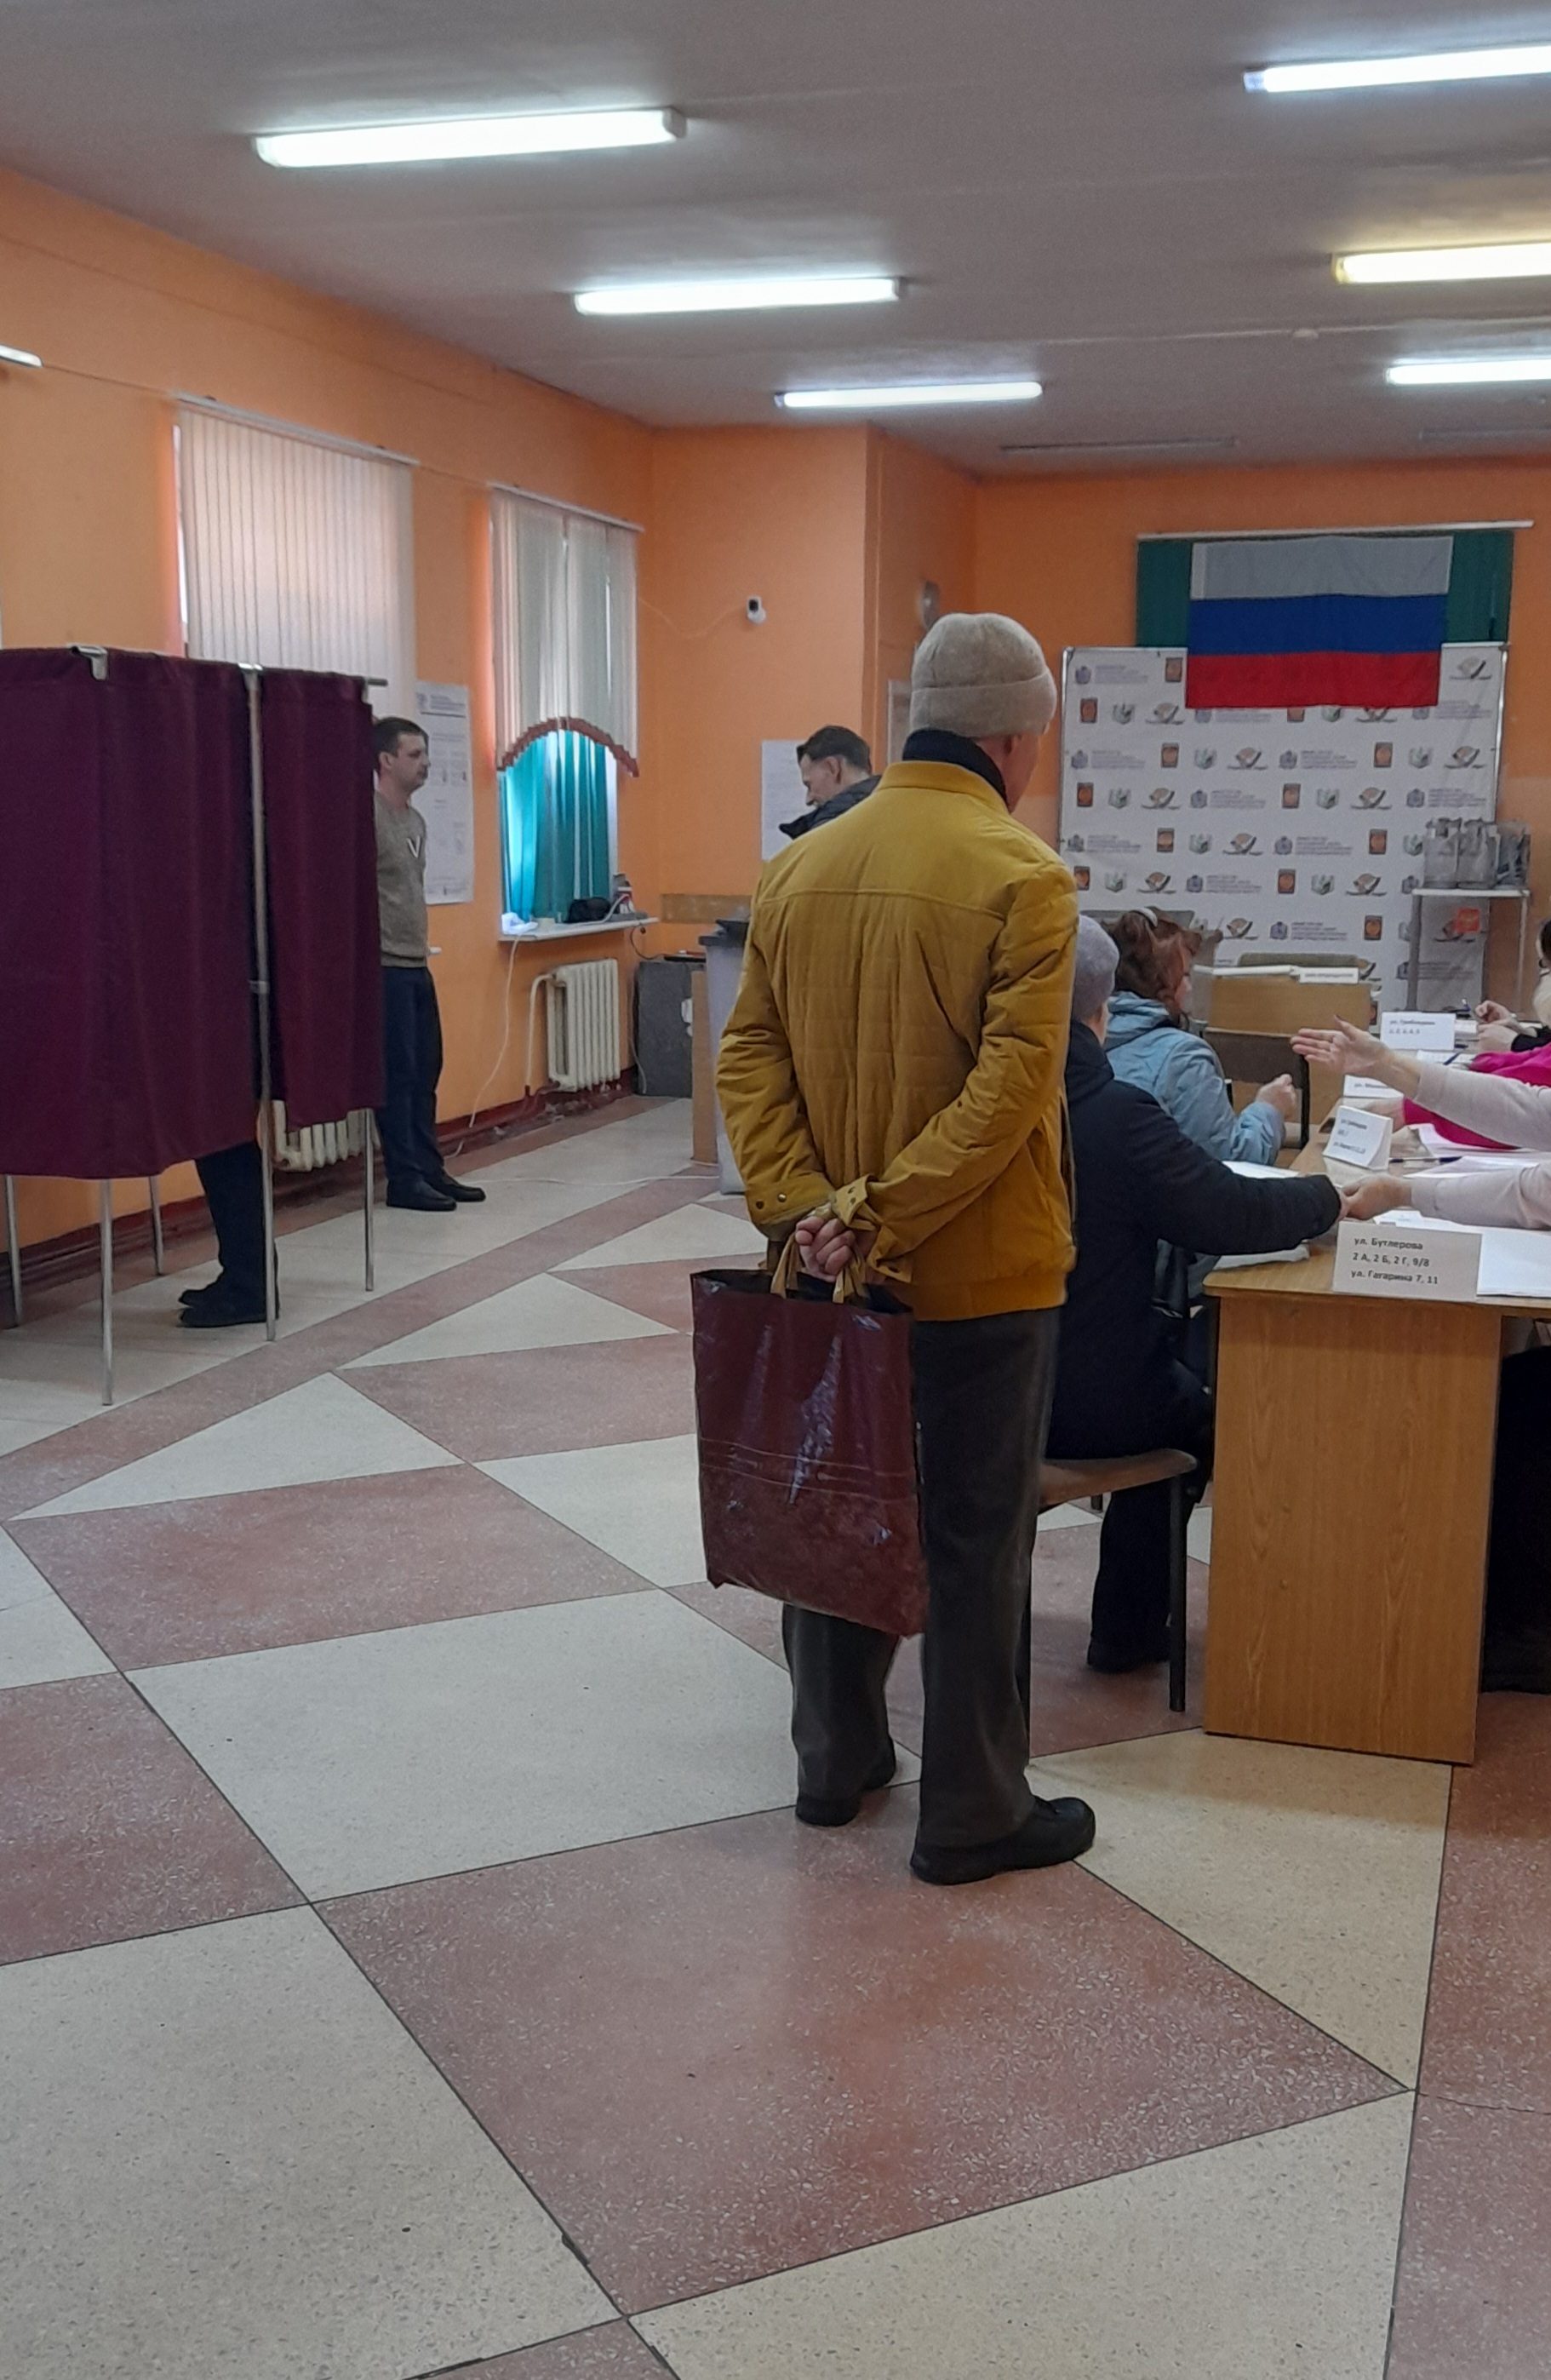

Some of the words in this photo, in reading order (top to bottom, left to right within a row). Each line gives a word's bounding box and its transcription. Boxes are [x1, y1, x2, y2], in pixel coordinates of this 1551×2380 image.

[1354, 1237, 1367, 1246] ул.
[1371, 1237, 1423, 1250] Бутлерова
[1353, 1252, 1359, 1261] 2
[1394, 1256, 1399, 1265] 2
[1351, 1270, 1365, 1278] ул.
[1428, 1276, 1438, 1285] 11
